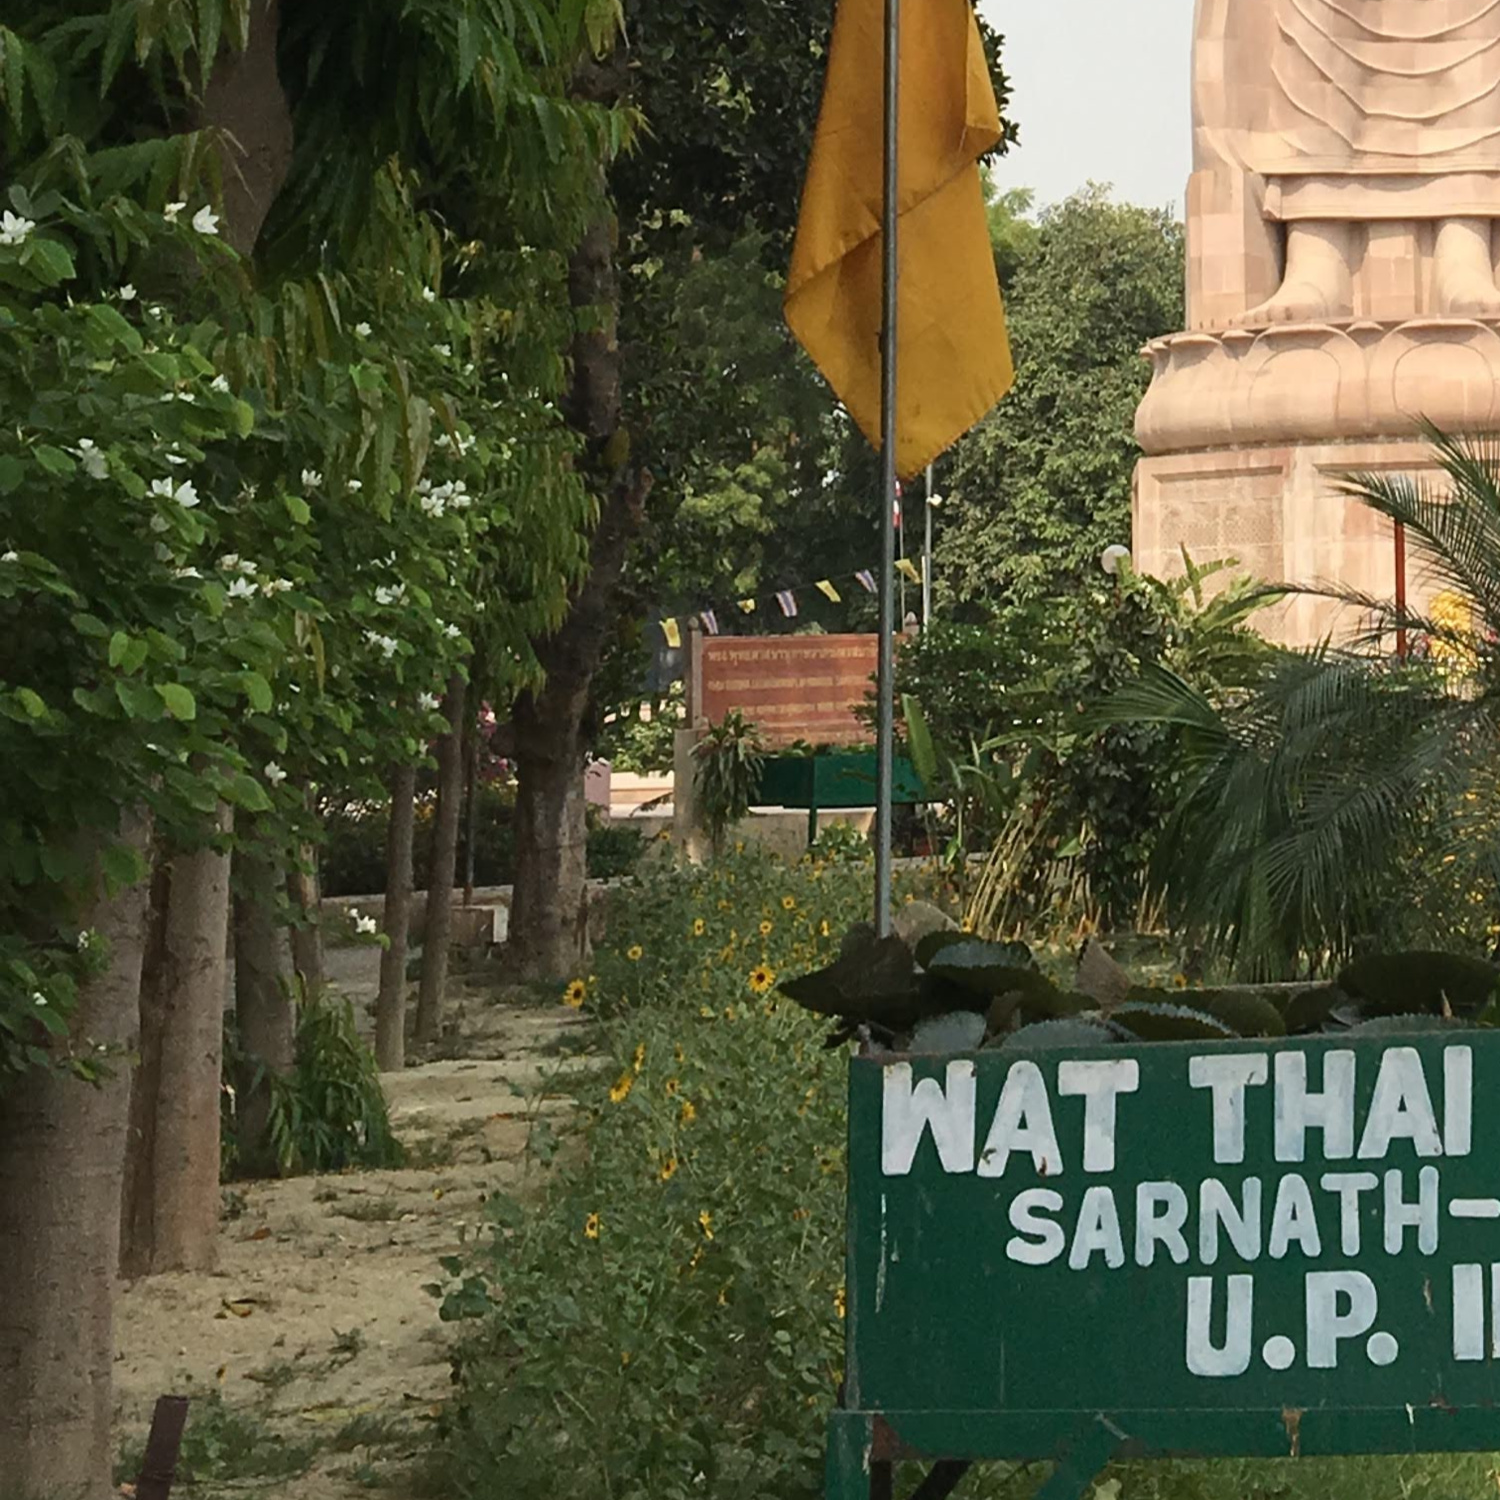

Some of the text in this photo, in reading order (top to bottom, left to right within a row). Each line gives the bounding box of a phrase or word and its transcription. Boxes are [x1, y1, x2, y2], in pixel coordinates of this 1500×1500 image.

[882, 1059, 1139, 1178] WAT
[1189, 1046, 1473, 1163] THAI
[1186, 1274, 1399, 1376] U.P.
